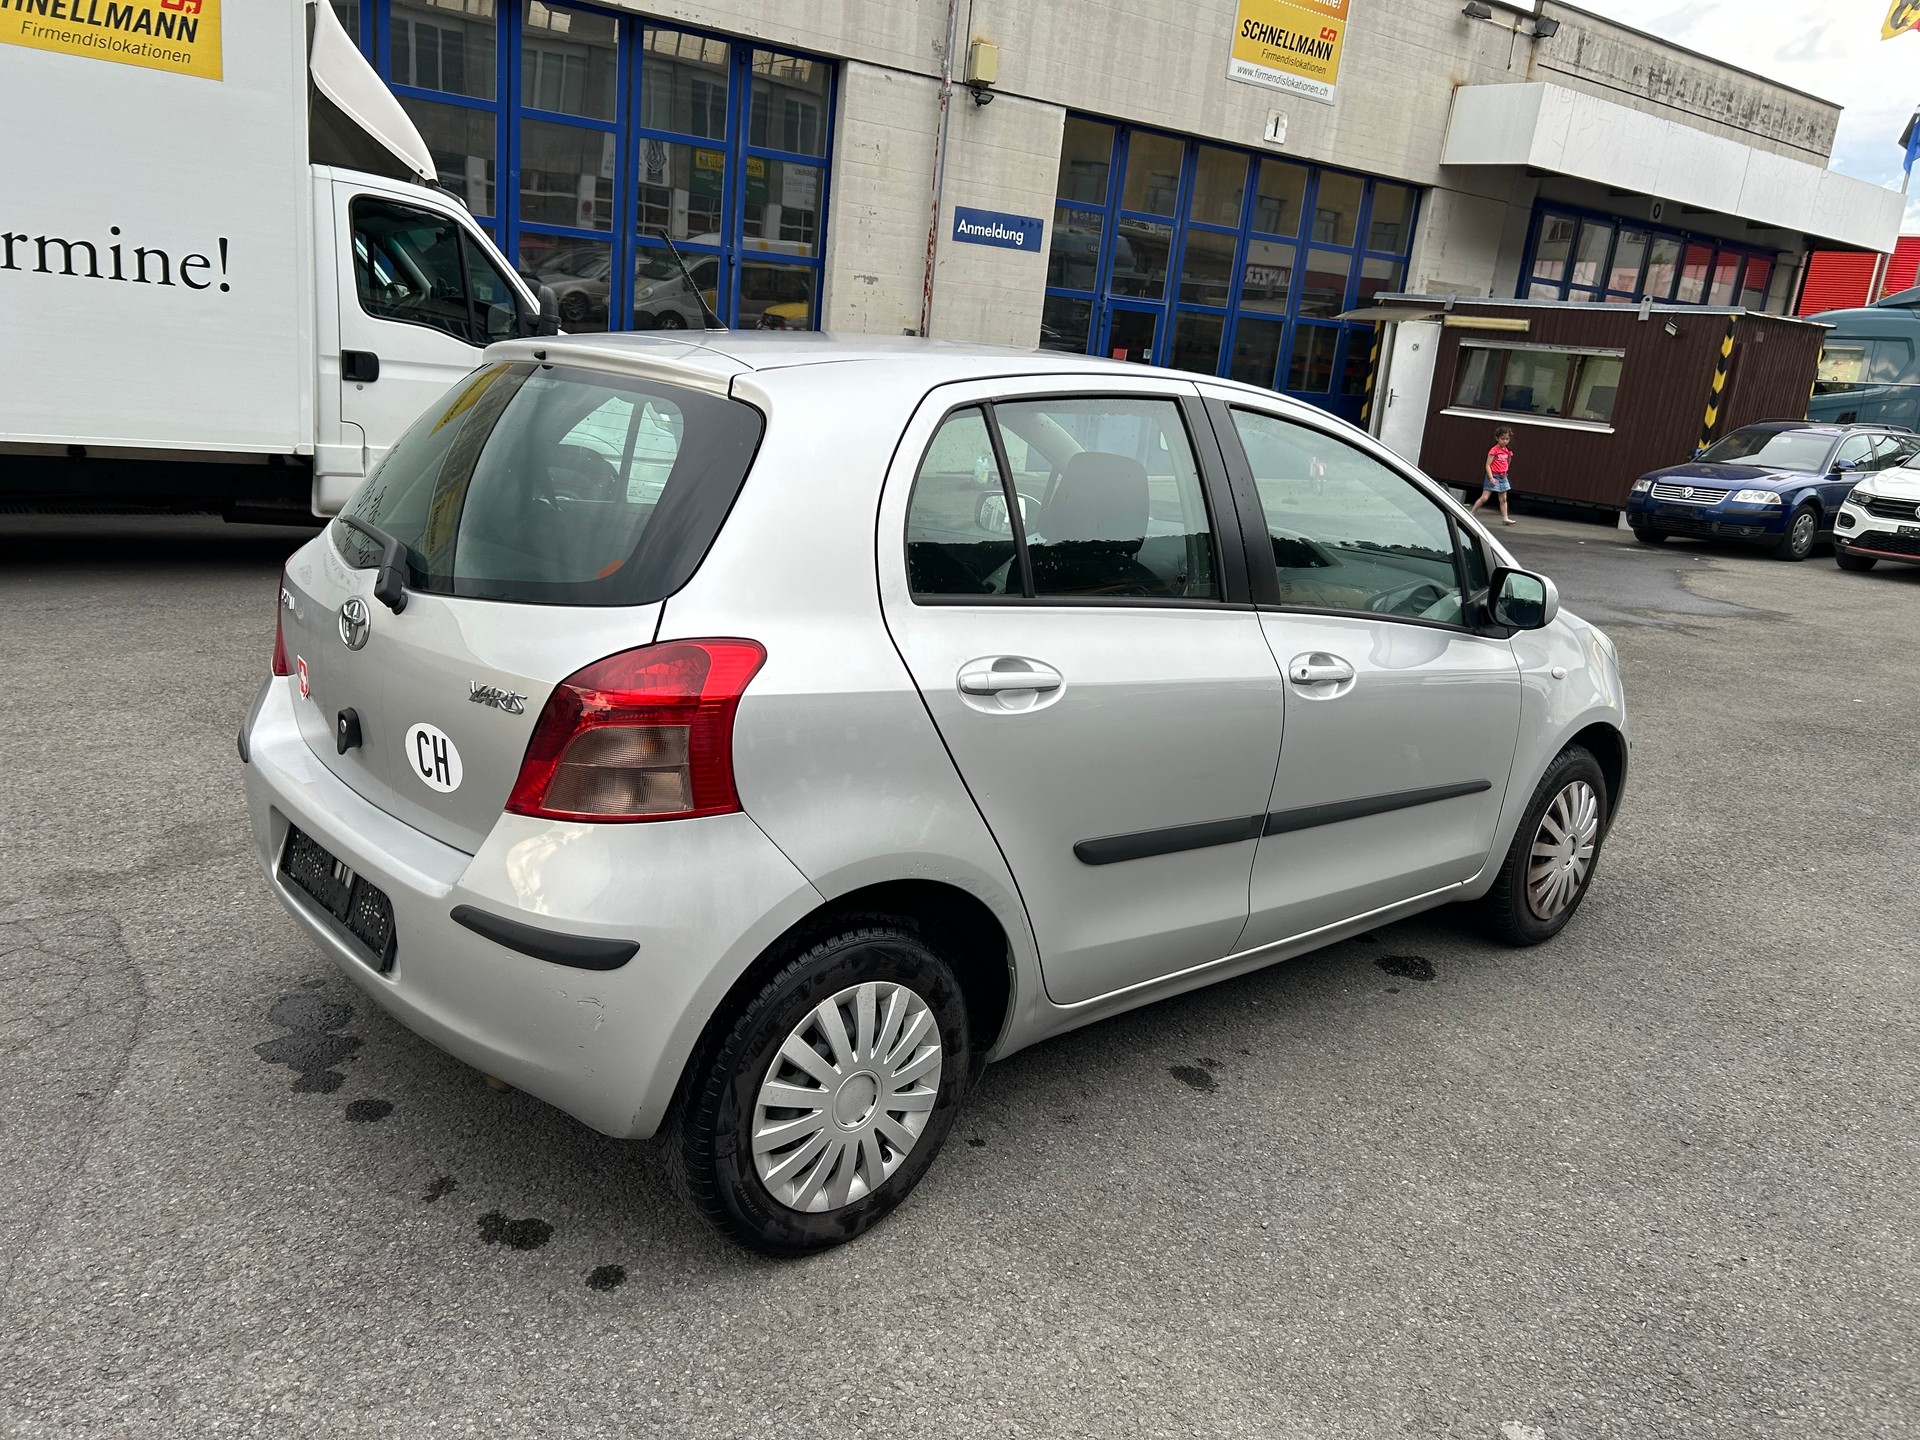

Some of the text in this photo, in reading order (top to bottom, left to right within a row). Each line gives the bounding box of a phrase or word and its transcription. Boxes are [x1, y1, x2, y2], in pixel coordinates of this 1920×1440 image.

[21, 20, 191, 63] Firmendislokationen
[1241, 19, 1334, 61] SCHNELLMANN
[1261, 48, 1326, 75] Firmendislokationen
[1237, 65, 1329, 97] www.firmendislokationen.ch
[1273, 116, 1280, 137] 1
[957, 219, 1024, 245] Anmeldung
[0, 225, 230, 292] rmine!
[416, 730, 451, 786] CH
